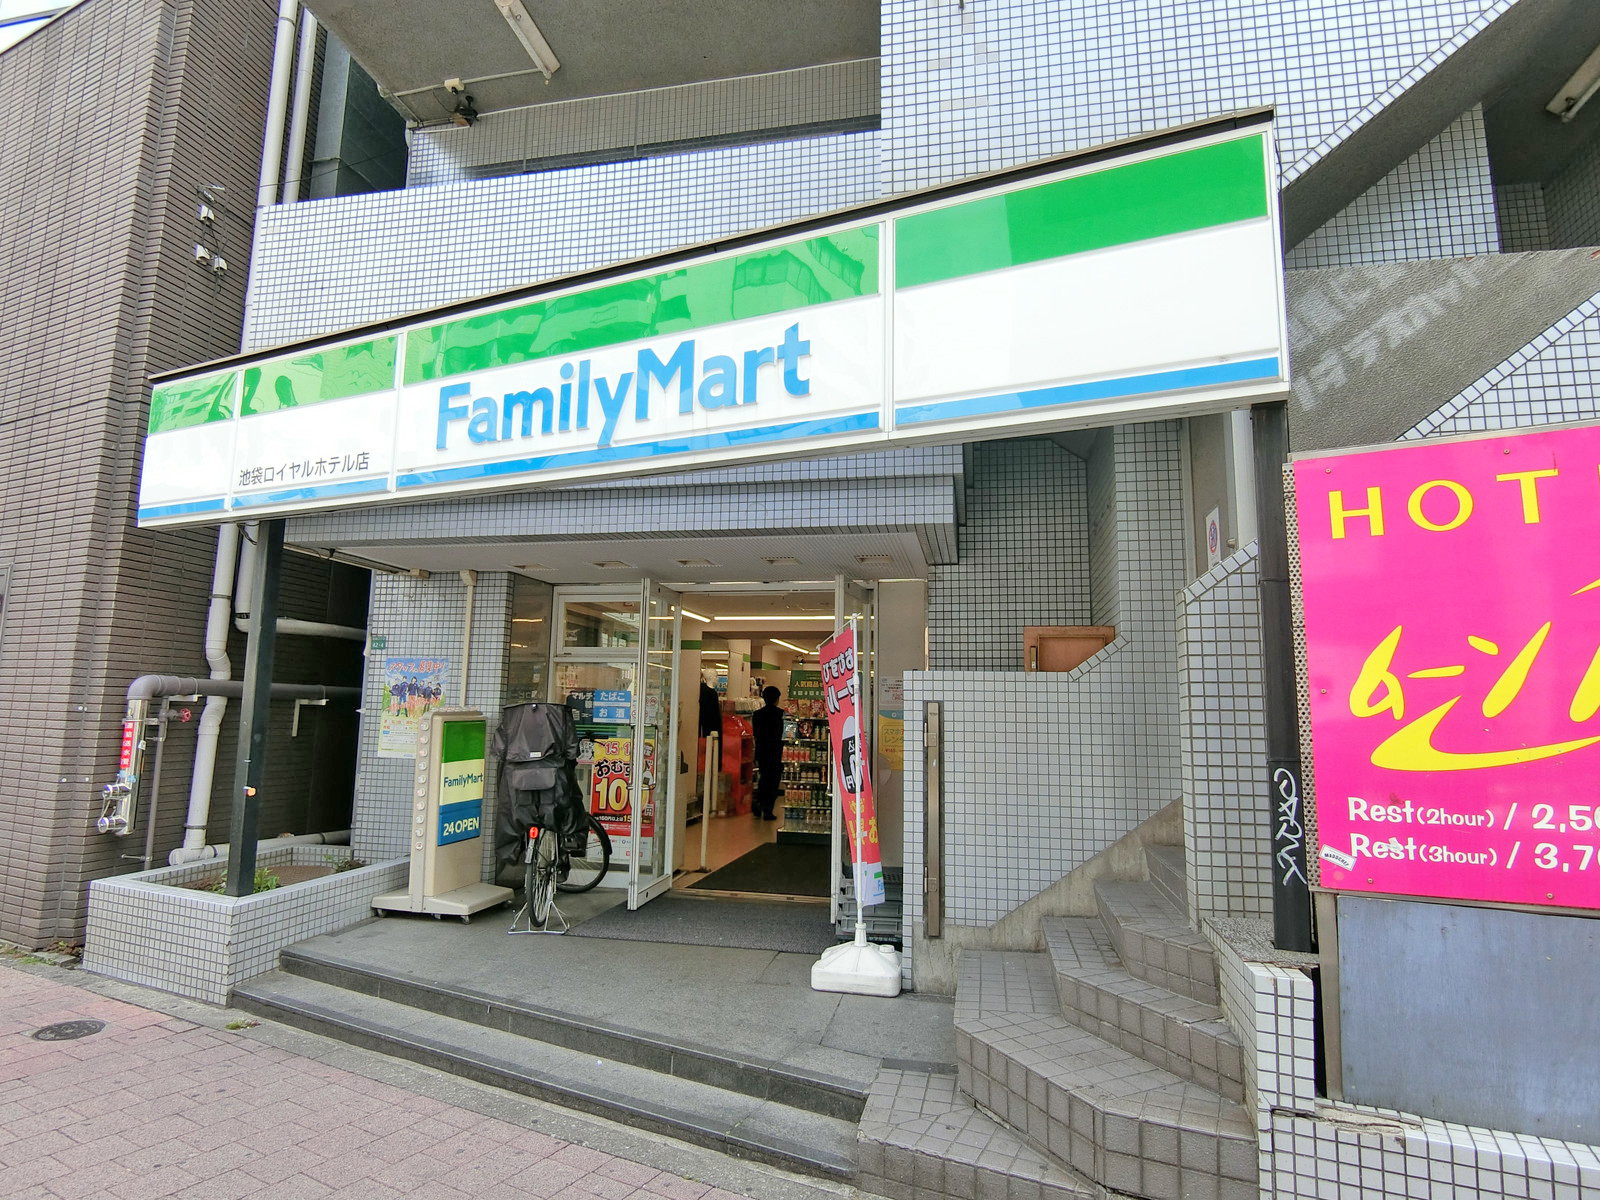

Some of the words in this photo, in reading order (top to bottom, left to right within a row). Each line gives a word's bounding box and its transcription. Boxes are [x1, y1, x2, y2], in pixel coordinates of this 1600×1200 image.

[436, 321, 812, 451] FamilyMart
[238, 451, 370, 487] 池袋ロイヤルホテル店
[1328, 463, 1600, 540] HOT
[600, 691, 625, 701] たばこ
[443, 772, 484, 789] FamilyMart
[1531, 802, 1600, 833] 2,5
[1534, 842, 1600, 873] 3,7
